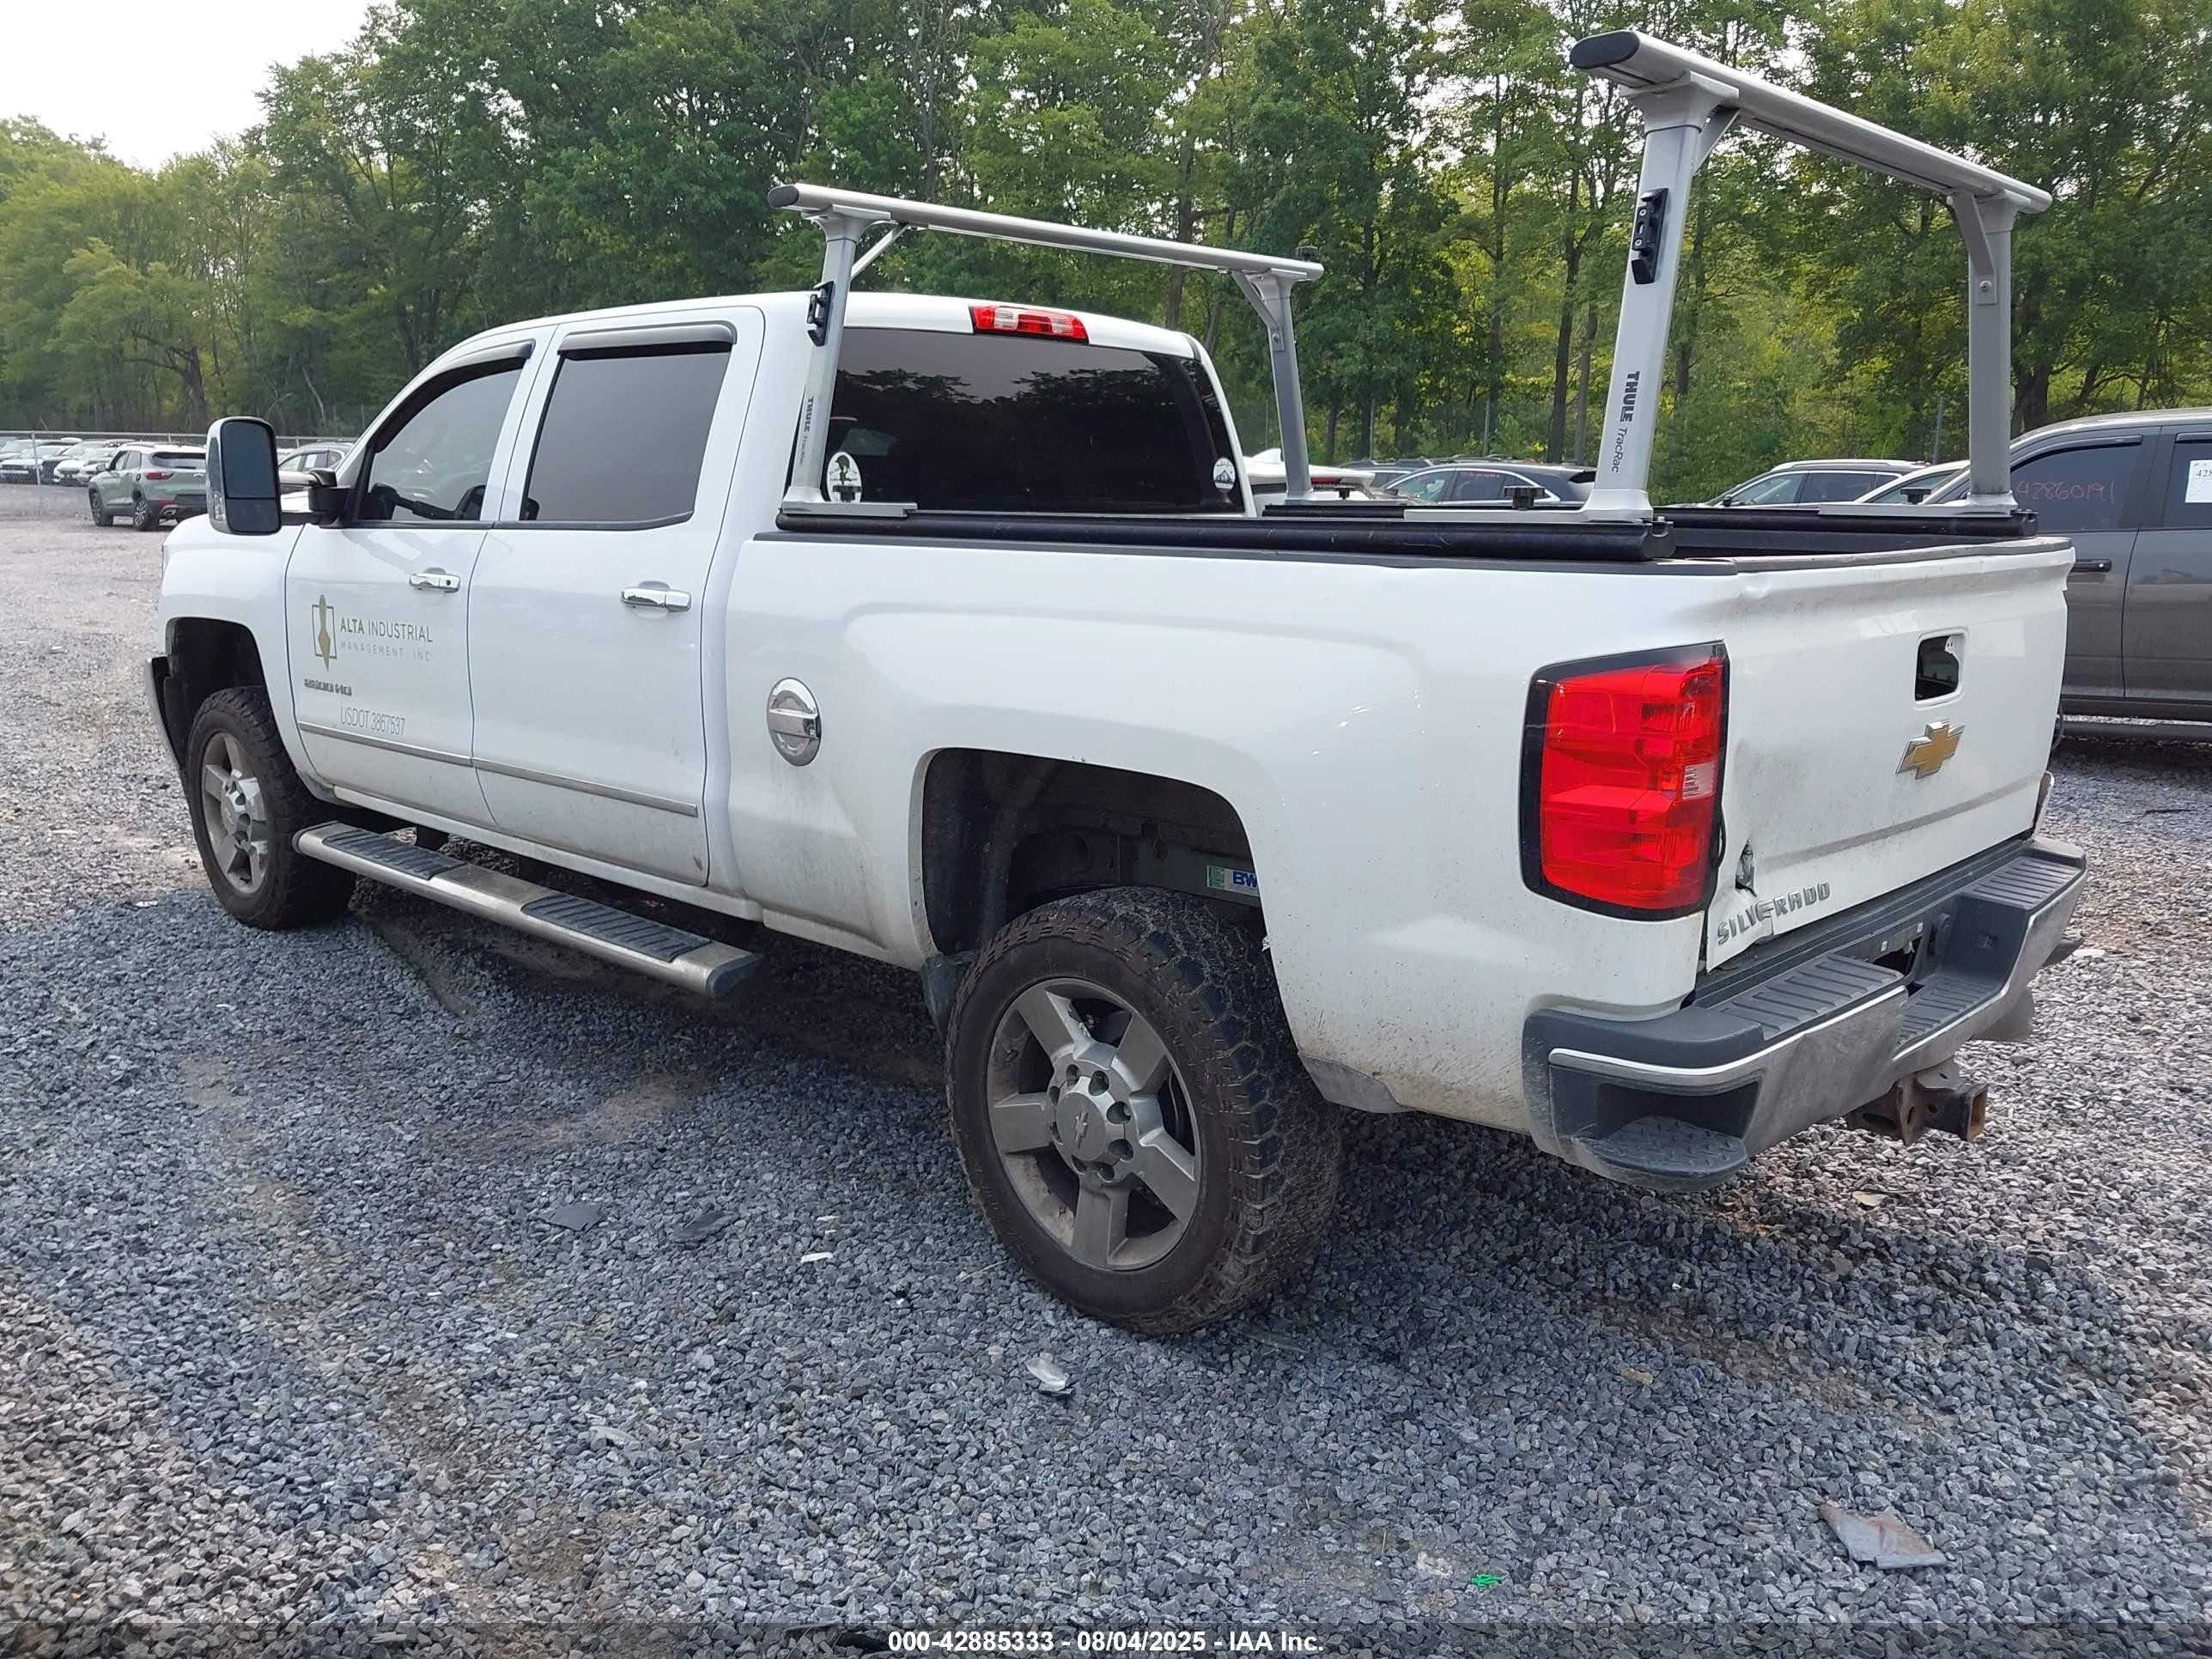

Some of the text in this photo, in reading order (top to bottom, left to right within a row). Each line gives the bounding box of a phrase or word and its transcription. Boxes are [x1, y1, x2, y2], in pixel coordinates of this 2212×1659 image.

[1611, 371, 1640, 473] THULE TracRac
[340, 617, 433, 642] ALTA INDUSTRIAL
[341, 642, 430, 661] MANAGEMENT INC
[340, 706, 370, 728] USDOT
[1717, 881, 1831, 945] SILVERADO
